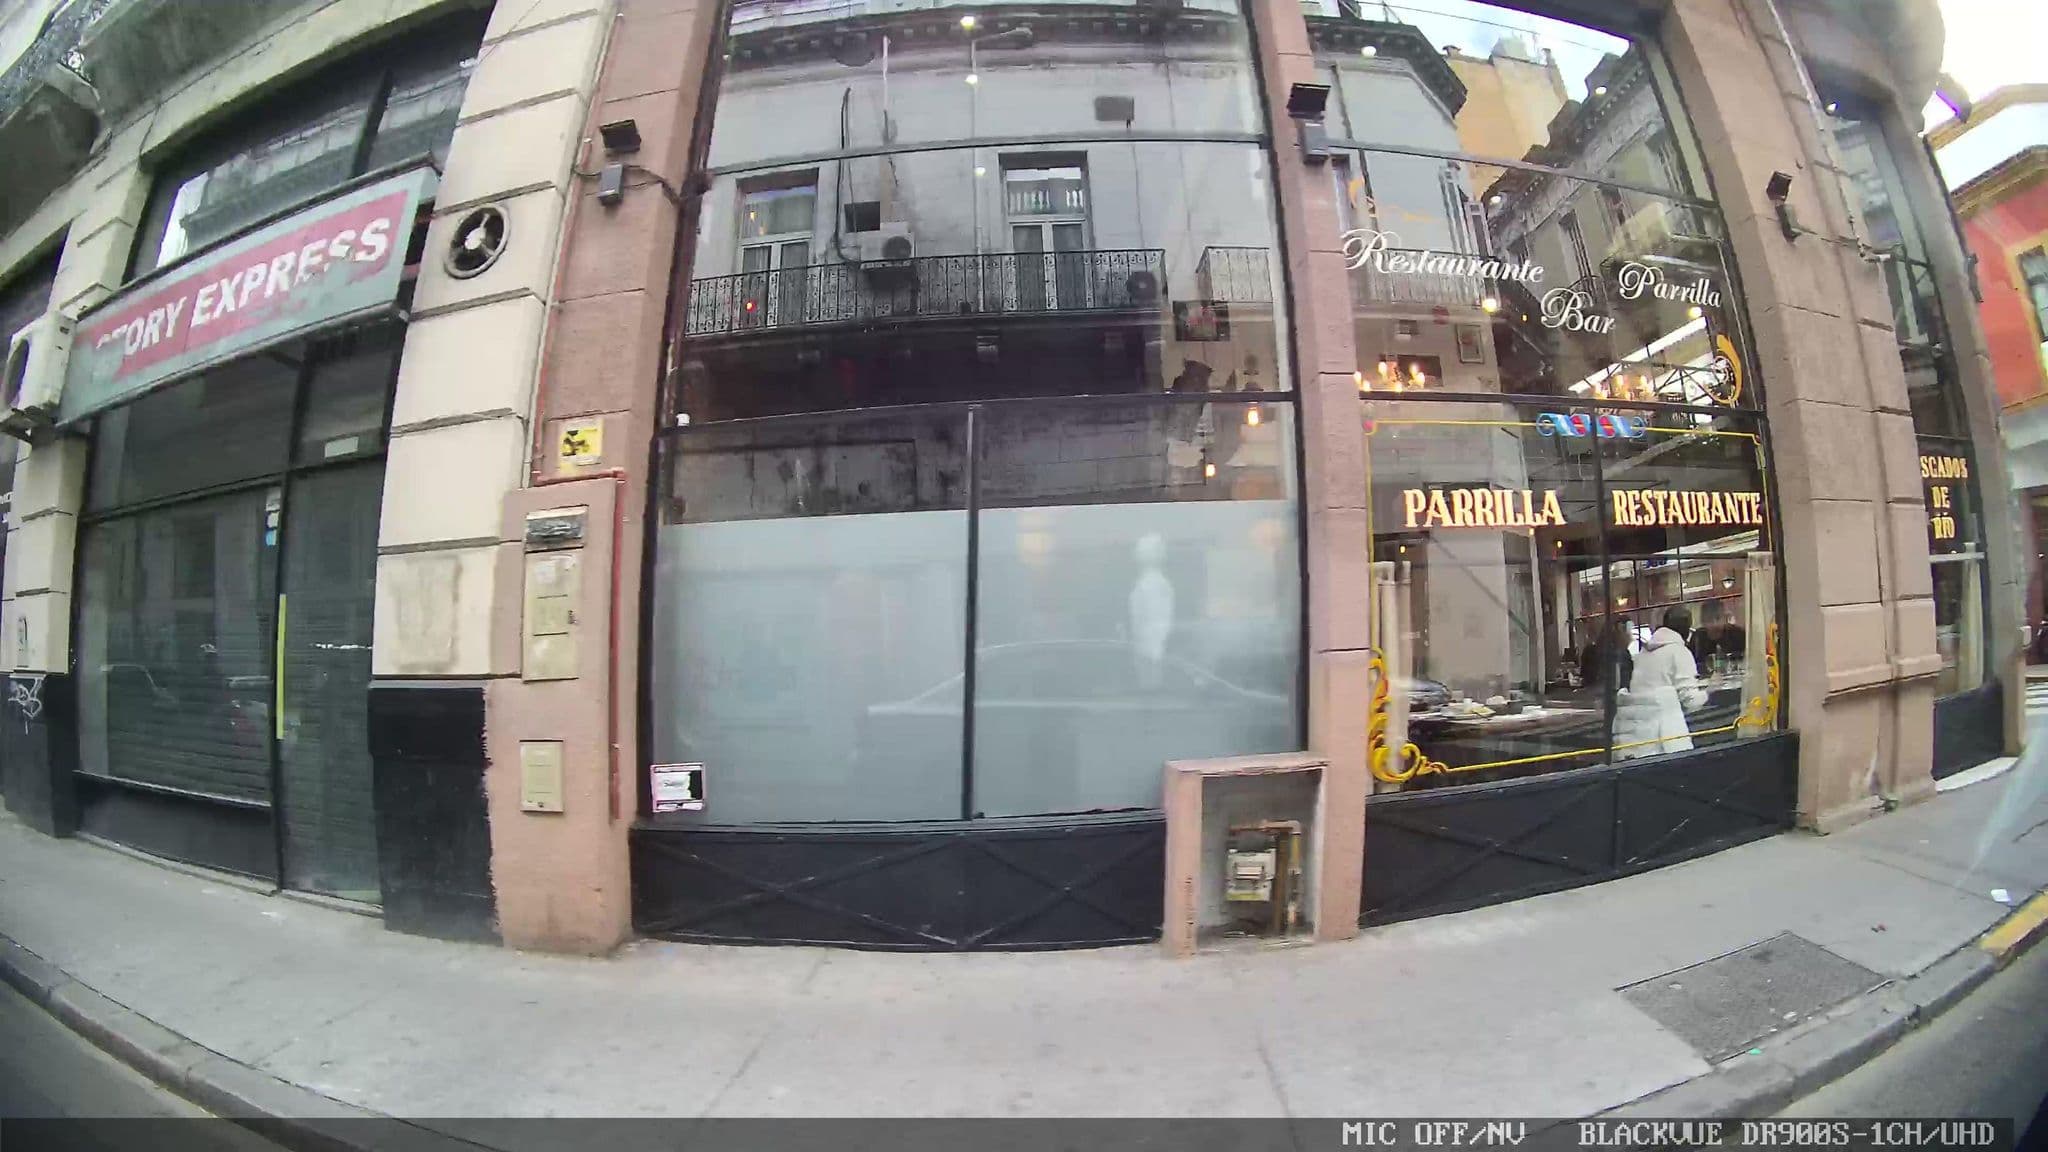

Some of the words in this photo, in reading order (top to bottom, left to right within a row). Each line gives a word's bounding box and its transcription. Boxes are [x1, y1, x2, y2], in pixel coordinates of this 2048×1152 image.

[1341, 228, 1545, 283] Restaurante
[1618, 260, 1722, 308] Parrilla
[1541, 287, 1616, 334] Bar
[1402, 488, 1568, 528] PARRILLA
[1611, 489, 1763, 526] RESTAURANTE
[1931, 486, 1951, 509] DE
